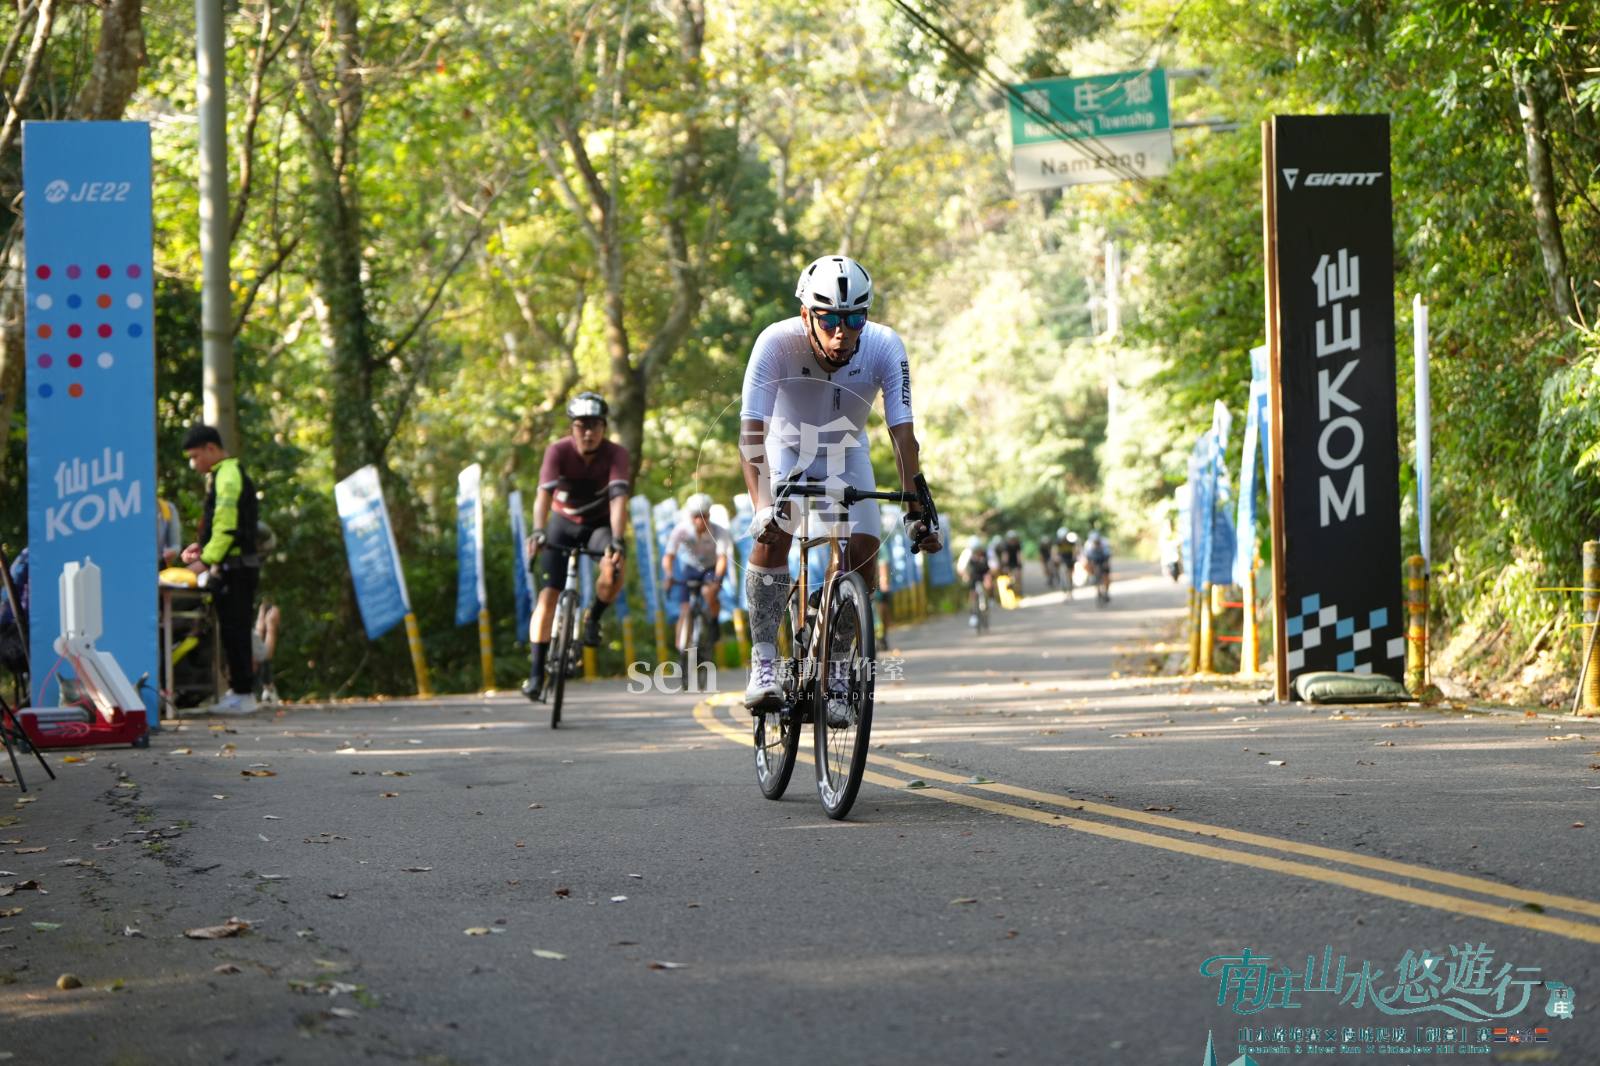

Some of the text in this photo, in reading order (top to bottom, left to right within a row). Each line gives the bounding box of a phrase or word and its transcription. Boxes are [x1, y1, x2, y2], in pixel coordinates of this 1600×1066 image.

[1097, 111, 1156, 130] Township
[1304, 171, 1384, 187] GIANT
[71, 181, 131, 203] JE22
[54, 447, 125, 500] 仙山
[45, 480, 142, 542] KOM
